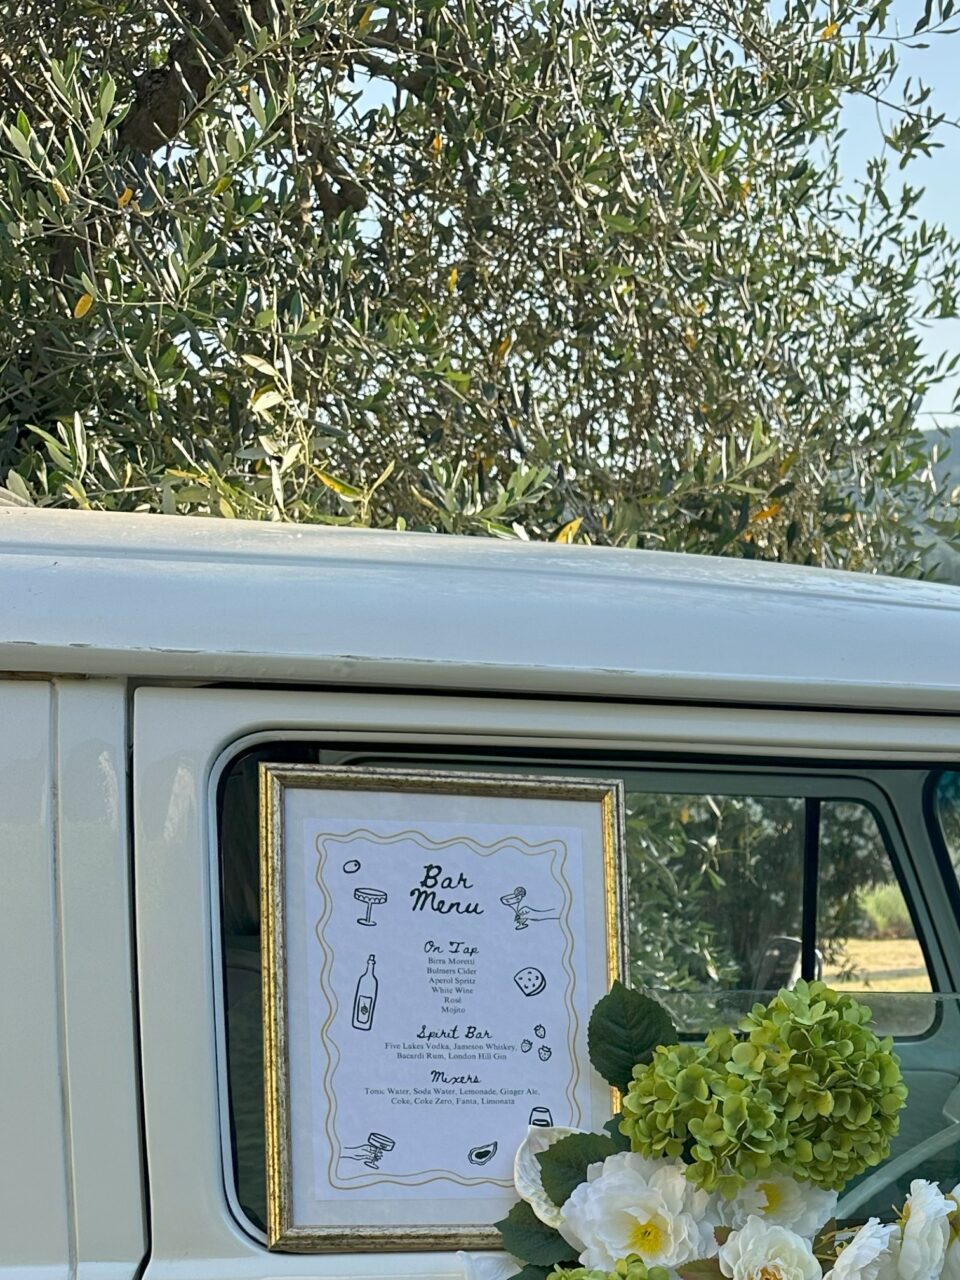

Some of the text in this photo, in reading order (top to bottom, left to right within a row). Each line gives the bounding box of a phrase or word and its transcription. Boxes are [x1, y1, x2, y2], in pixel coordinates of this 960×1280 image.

[420, 864, 474, 889] Bar
[410, 888, 484, 915] Menu
[424, 940, 479, 957] On Tap
[428, 957, 475, 965] Birra Moretti
[457, 967, 477, 975] Cider
[429, 977, 476, 986] Aperol Spritz
[432, 986, 453, 994] White
[441, 1006, 466, 1015] Mojito
[416, 1024, 493, 1041] Spirit Bar
[384, 1042, 401, 1050] Five
[402, 1042, 424, 1050] Lakes
[425, 1042, 451, 1051] Vodka,
[485, 1043, 518, 1052] Whiskey,
[397, 1052, 507, 1061] Bacardi Rum, London Hill Gin
[430, 1070, 481, 1085] Mixers
[364, 1087, 541, 1097] Tonic Water, Soda Water, Lemonade, Ginger Ale,
[391, 1097, 413, 1106] Coke,
[414, 1097, 434, 1105] Coke
[435, 1097, 455, 1106] Zero,
[456, 1097, 480, 1106] Fanta,
